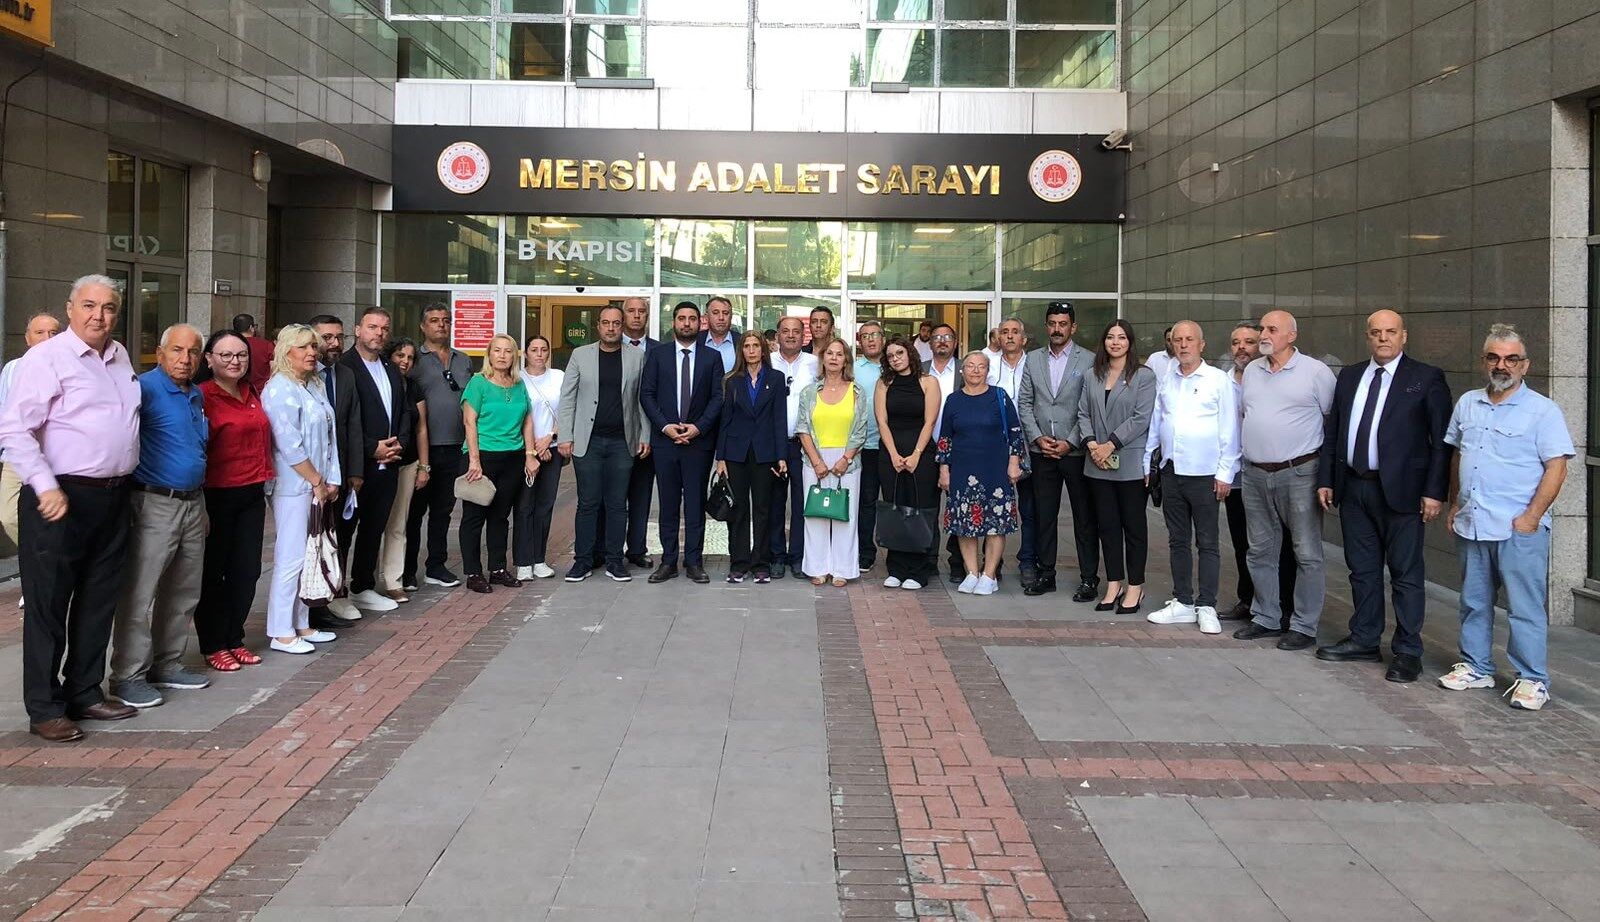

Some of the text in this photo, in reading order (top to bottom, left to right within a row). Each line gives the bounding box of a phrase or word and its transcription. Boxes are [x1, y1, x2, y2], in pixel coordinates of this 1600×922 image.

[519, 152, 1000, 195] MERSİN ADALET SARAYI
[518, 239, 642, 262] B KAPISI
[568, 327, 586, 339] GİRİŞ
